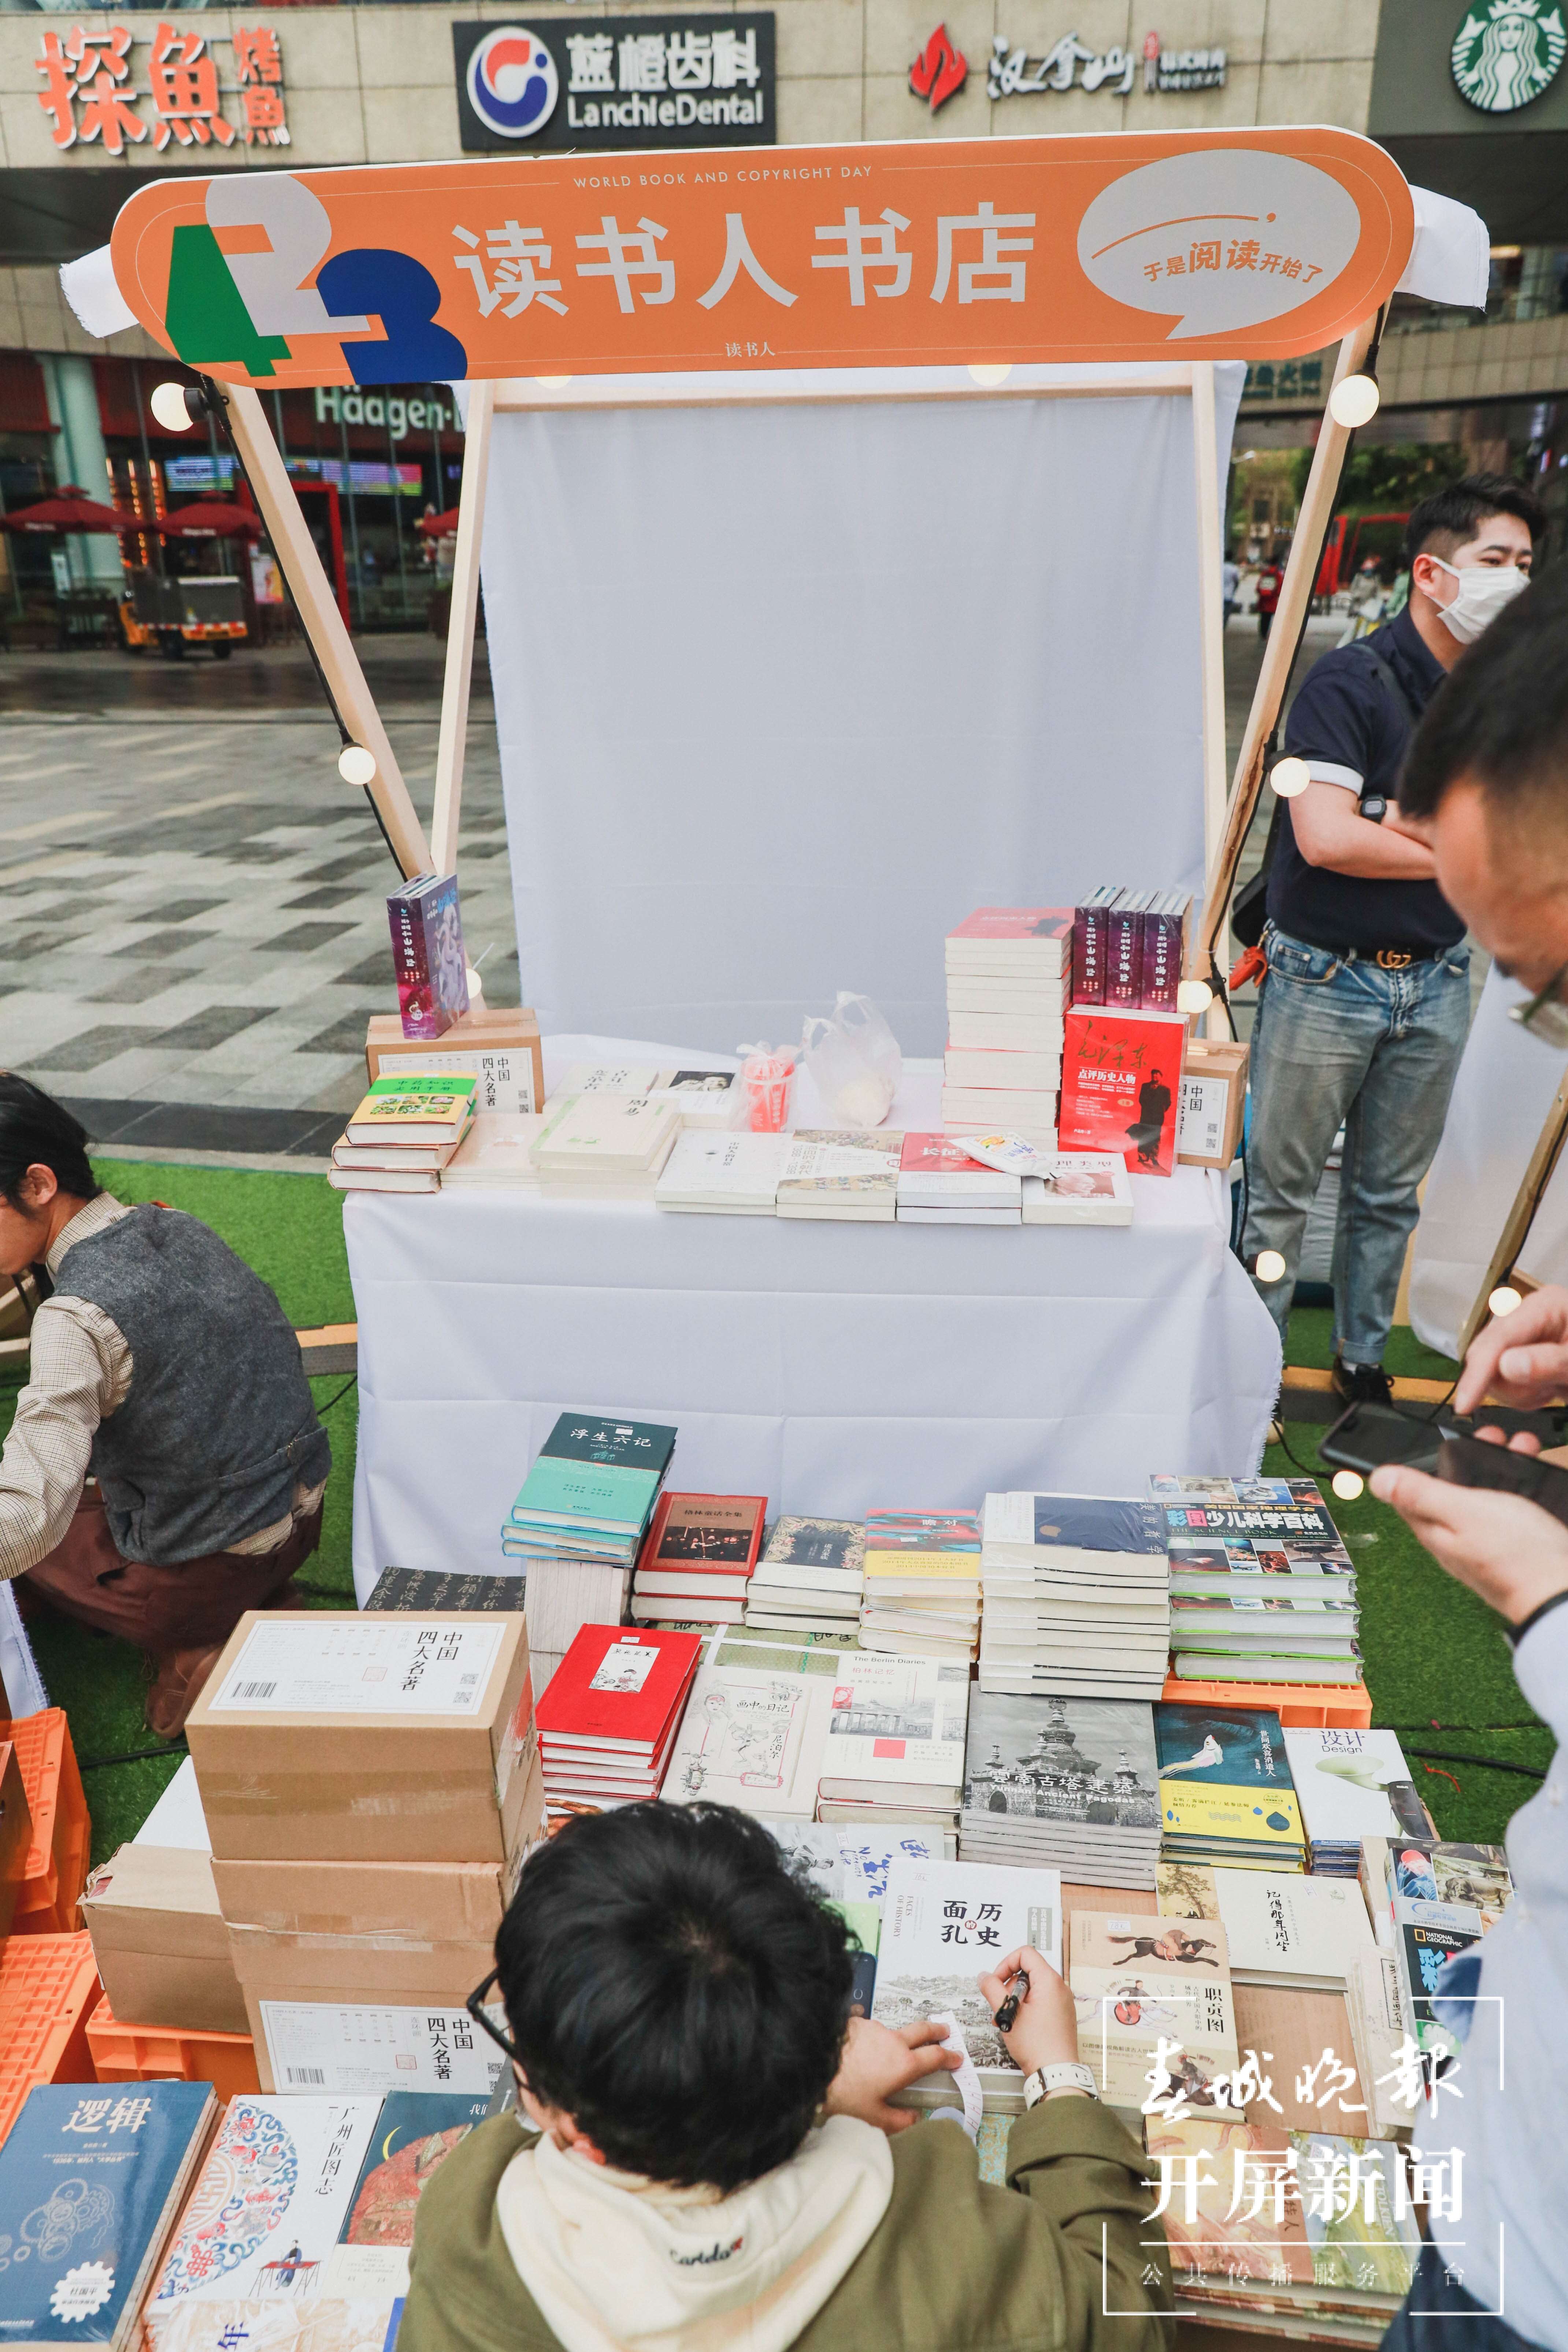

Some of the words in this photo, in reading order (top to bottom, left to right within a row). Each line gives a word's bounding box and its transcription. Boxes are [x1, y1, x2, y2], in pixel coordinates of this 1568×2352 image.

[566, 29, 761, 92] 蓝橙齿科
[573, 177, 631, 188] WORLD
[640, 173, 686, 186] BOOK
[694, 171, 729, 183] AND
[737, 167, 833, 182] COPYRIGHT
[841, 166, 873, 178] DAY
[451, 201, 1037, 319] 读书人书店
[1143, 239, 1323, 283] 于是阅读开始了
[725, 341, 776, 358] 读书人
[483, 1057, 497, 1106] 四大名著
[497, 1057, 510, 1081] 中国
[1078, 1068, 1136, 1084] 点评历史人物
[1190, 1086, 1202, 1111] 中国
[570, 1428, 651, 1447] 浮生六记
[684, 1509, 743, 1518] 格林童话全集
[1166, 1509, 1325, 1530] 彩图少儿科学百科
[436, 1632, 462, 1661] 中国
[400, 1631, 438, 1691] 四大名著
[852, 1667, 895, 1676] 柏林记忆
[737, 1700, 790, 1713] 画中的日记
[769, 1735, 782, 1759] 尼泊尔
[1319, 1730, 1366, 1746] 设计
[1321, 1746, 1363, 1754] Design
[1259, 1730, 1276, 1777] 世间欢喜消遣人
[990, 1770, 1134, 1795] 雲南古塔建築
[990, 1784, 1032, 1794] Yunnan
[1036, 1789, 1081, 1800] Ancient
[1086, 1794, 1135, 1804] Pagodas
[897, 1895, 904, 1906] OF
[905, 1896, 914, 1916] FACES
[893, 1906, 904, 1938] HISTORY
[941, 1900, 968, 1944] 面孔
[965, 1920, 977, 1930] 的
[975, 1903, 1003, 1947] 历史
[1266, 1890, 1290, 1952] 记得那年同坐
[1426, 1931, 1454, 1941] NATIONAL
[1426, 1937, 1463, 1948] GEOGRAPHIC
[1205, 1987, 1224, 2033] 职贡图
[452, 2018, 473, 2049] 中国
[427, 2017, 453, 2080] 四大名著
[61, 2097, 152, 2134] 逻辑
[314, 2106, 360, 2196] 广州匠图志
[218, 2322, 249, 2350] 年
